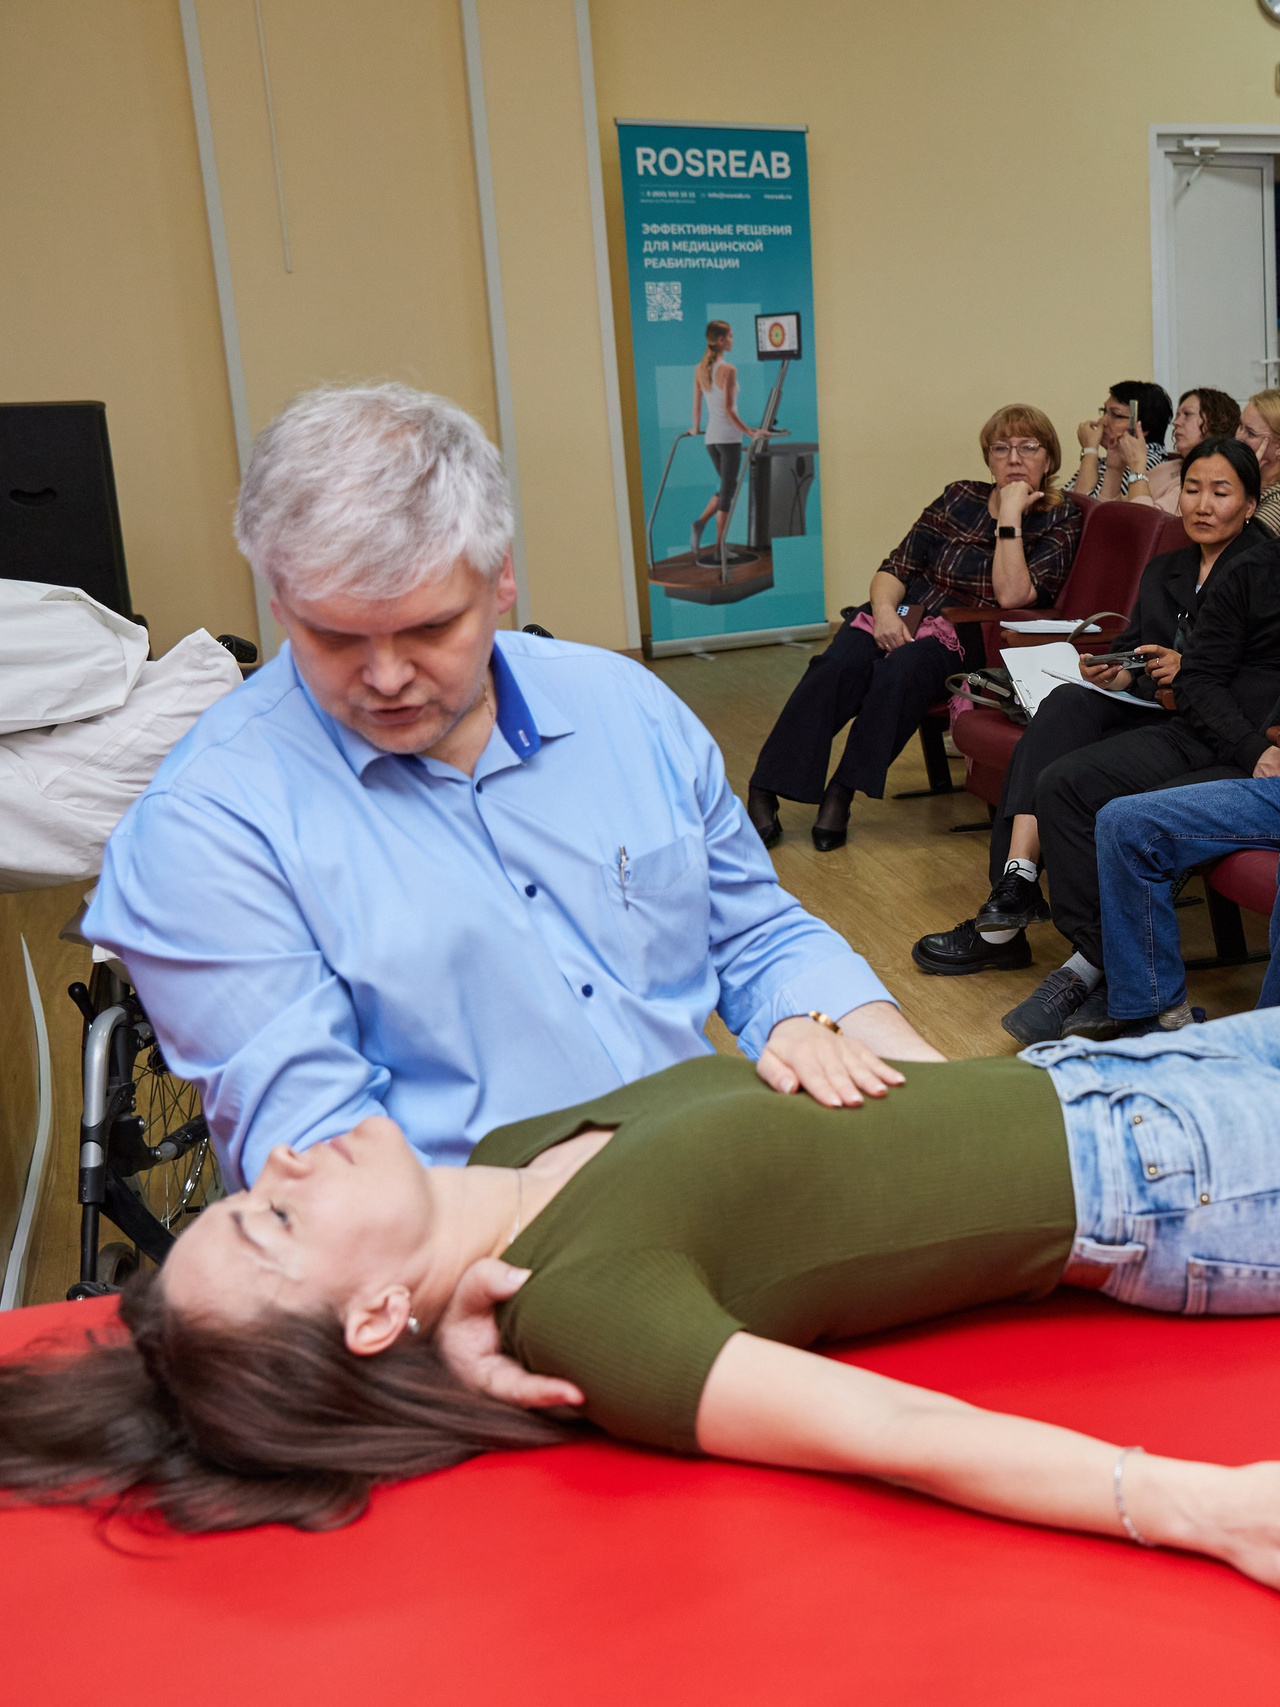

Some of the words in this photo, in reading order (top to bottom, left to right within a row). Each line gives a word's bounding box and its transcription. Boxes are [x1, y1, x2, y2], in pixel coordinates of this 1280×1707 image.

[635, 147, 792, 179] ROSREAB
[641, 223, 734, 236] ЭФФЕКТИВНЫЕ
[736, 224, 793, 236] РЕШЕНИЯ
[643, 240, 670, 253] ДЛЯ
[672, 239, 764, 254] МЕДИЦИНСКОЙ
[644, 257, 740, 270] РЕАБИЛИТАЦИИ
